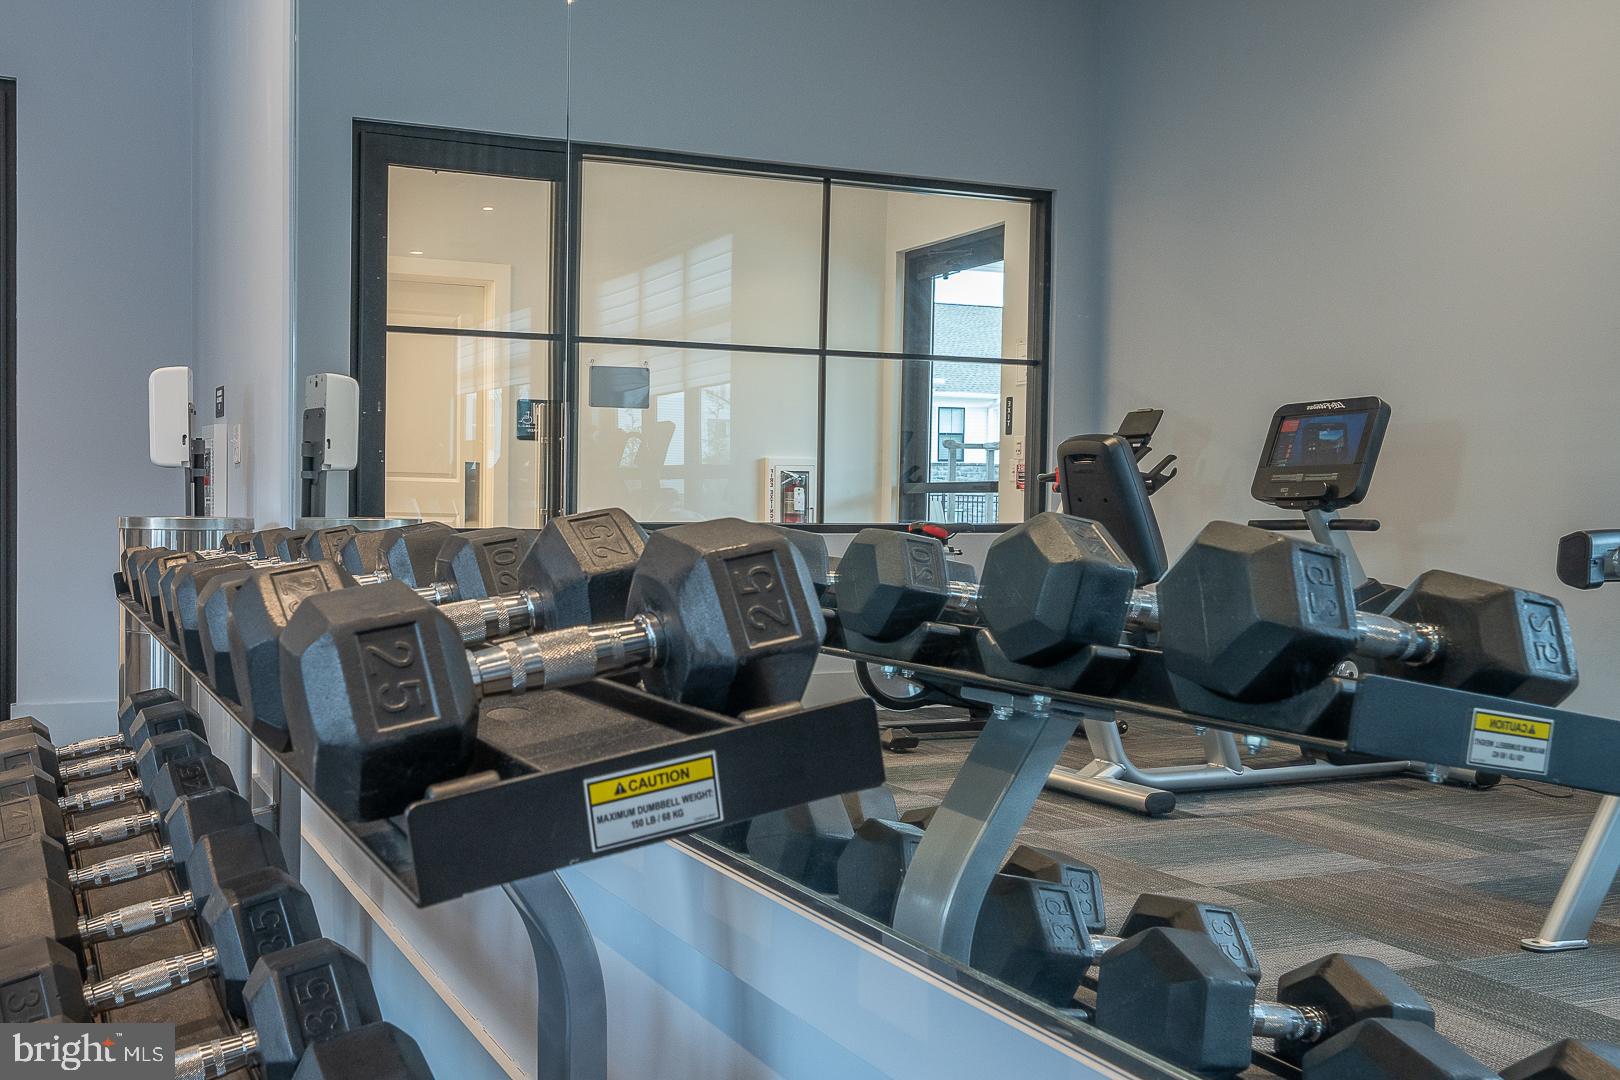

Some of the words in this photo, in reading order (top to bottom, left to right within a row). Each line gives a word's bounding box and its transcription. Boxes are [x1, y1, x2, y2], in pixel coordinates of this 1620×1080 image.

[733, 564, 789, 632] 25
[366, 640, 426, 713] 25
[628, 767, 690, 792] CAUTION
[596, 807, 636, 824] MAXIMUM
[637, 797, 681, 815] DUMBBELL
[631, 819, 645, 829] 150
[645, 815, 657, 826] LB
[672, 808, 685, 819] KG
[294, 976, 340, 1036] 35
